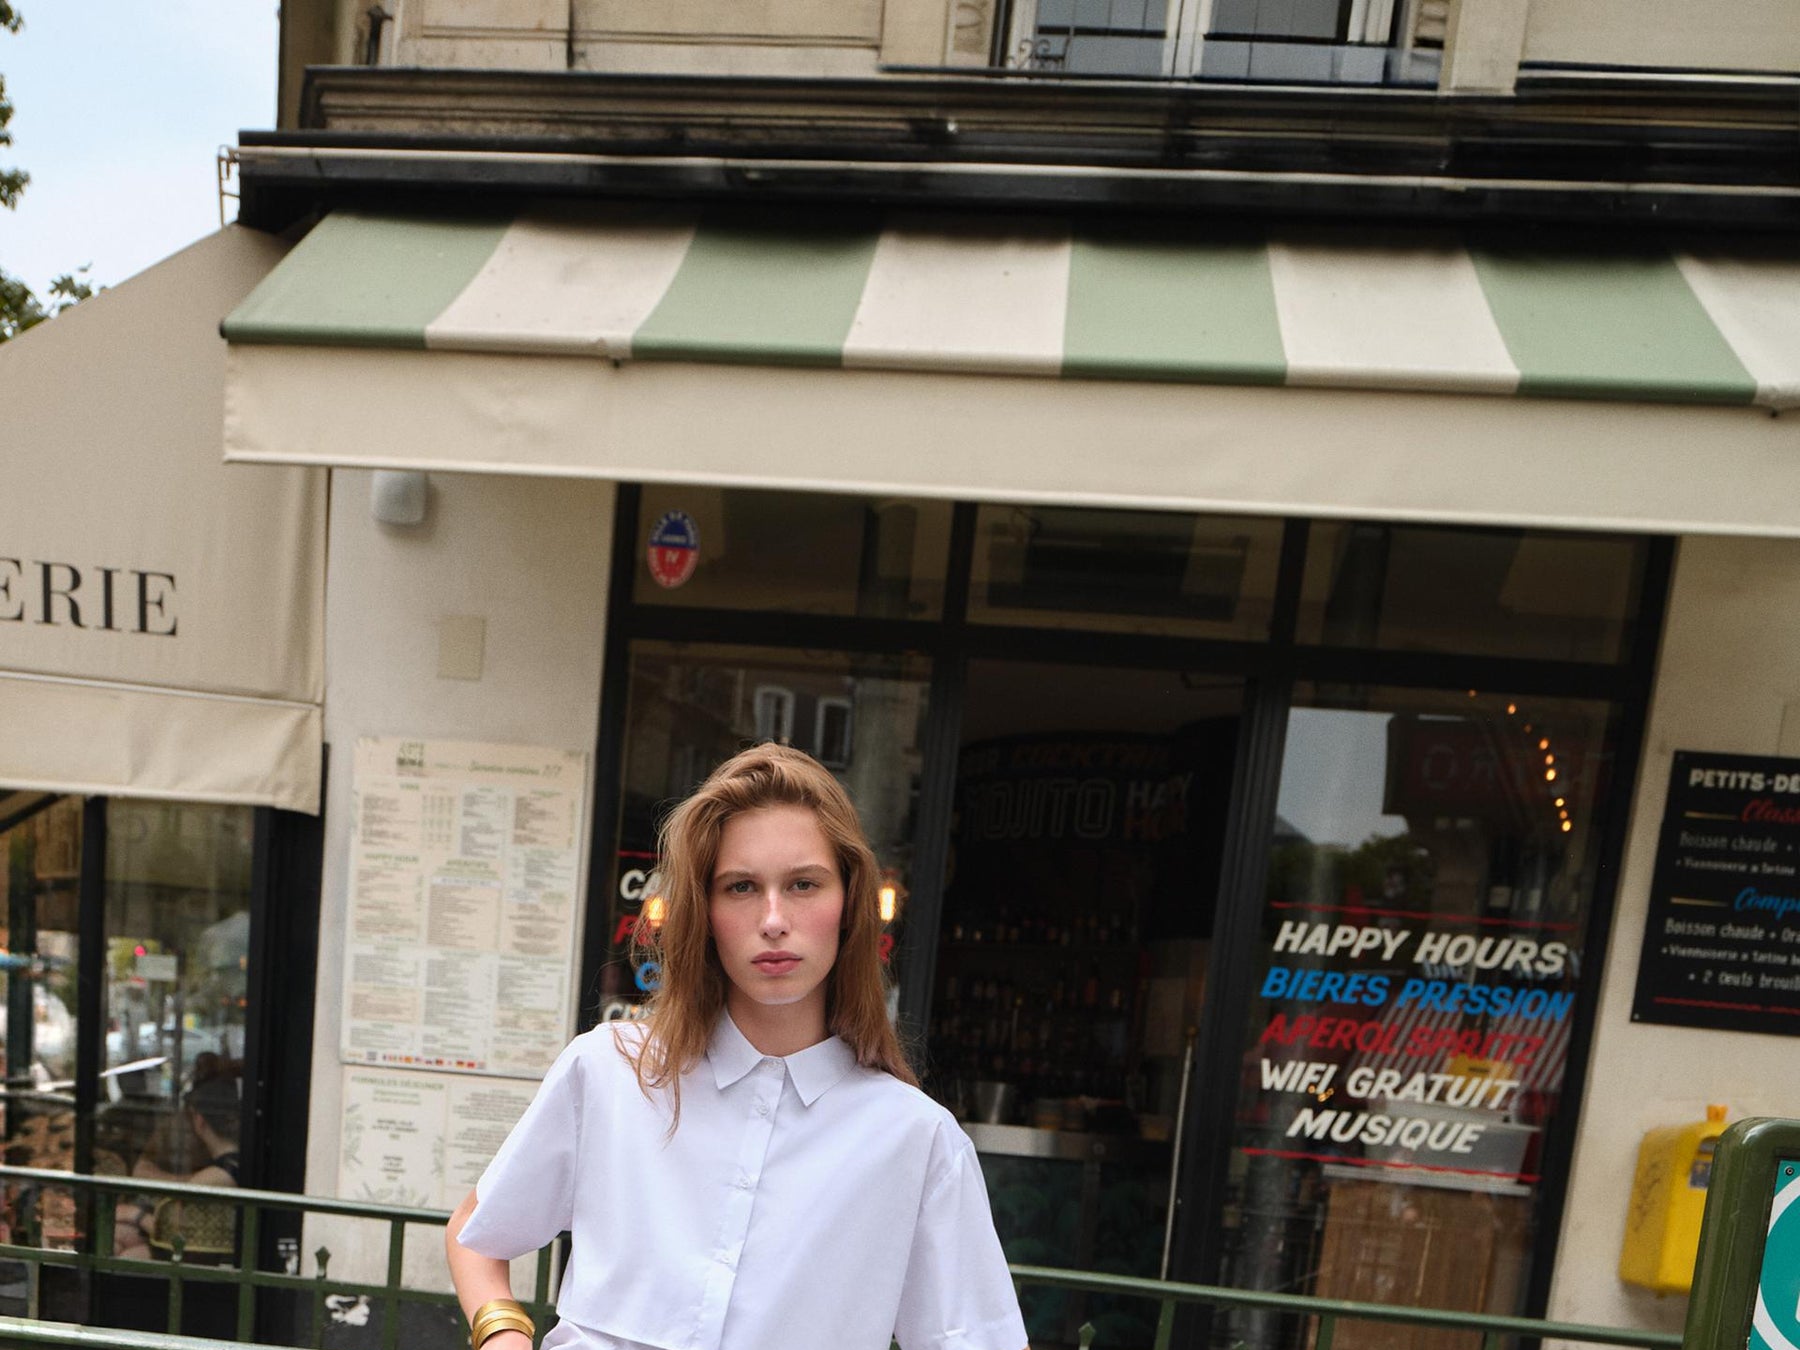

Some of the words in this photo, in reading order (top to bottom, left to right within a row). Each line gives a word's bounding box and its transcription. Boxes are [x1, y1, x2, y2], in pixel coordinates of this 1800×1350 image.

[1731, 837, 1778, 854] chaude
[1273, 920, 1411, 961] HAPPY
[1413, 932, 1569, 974] HOURS
[1665, 917, 1716, 937] Boisson
[1719, 922, 1765, 941] chaude
[1261, 966, 1389, 1007] BIERES
[1396, 979, 1575, 1021] PRESSION
[1260, 1013, 1400, 1055] APEROL
[1404, 1026, 1546, 1065] SPRITZ
[1260, 1057, 1338, 1094] WIFI
[1346, 1066, 1521, 1110] GRATUIT
[1286, 1107, 1485, 1155] MUSIQUE
